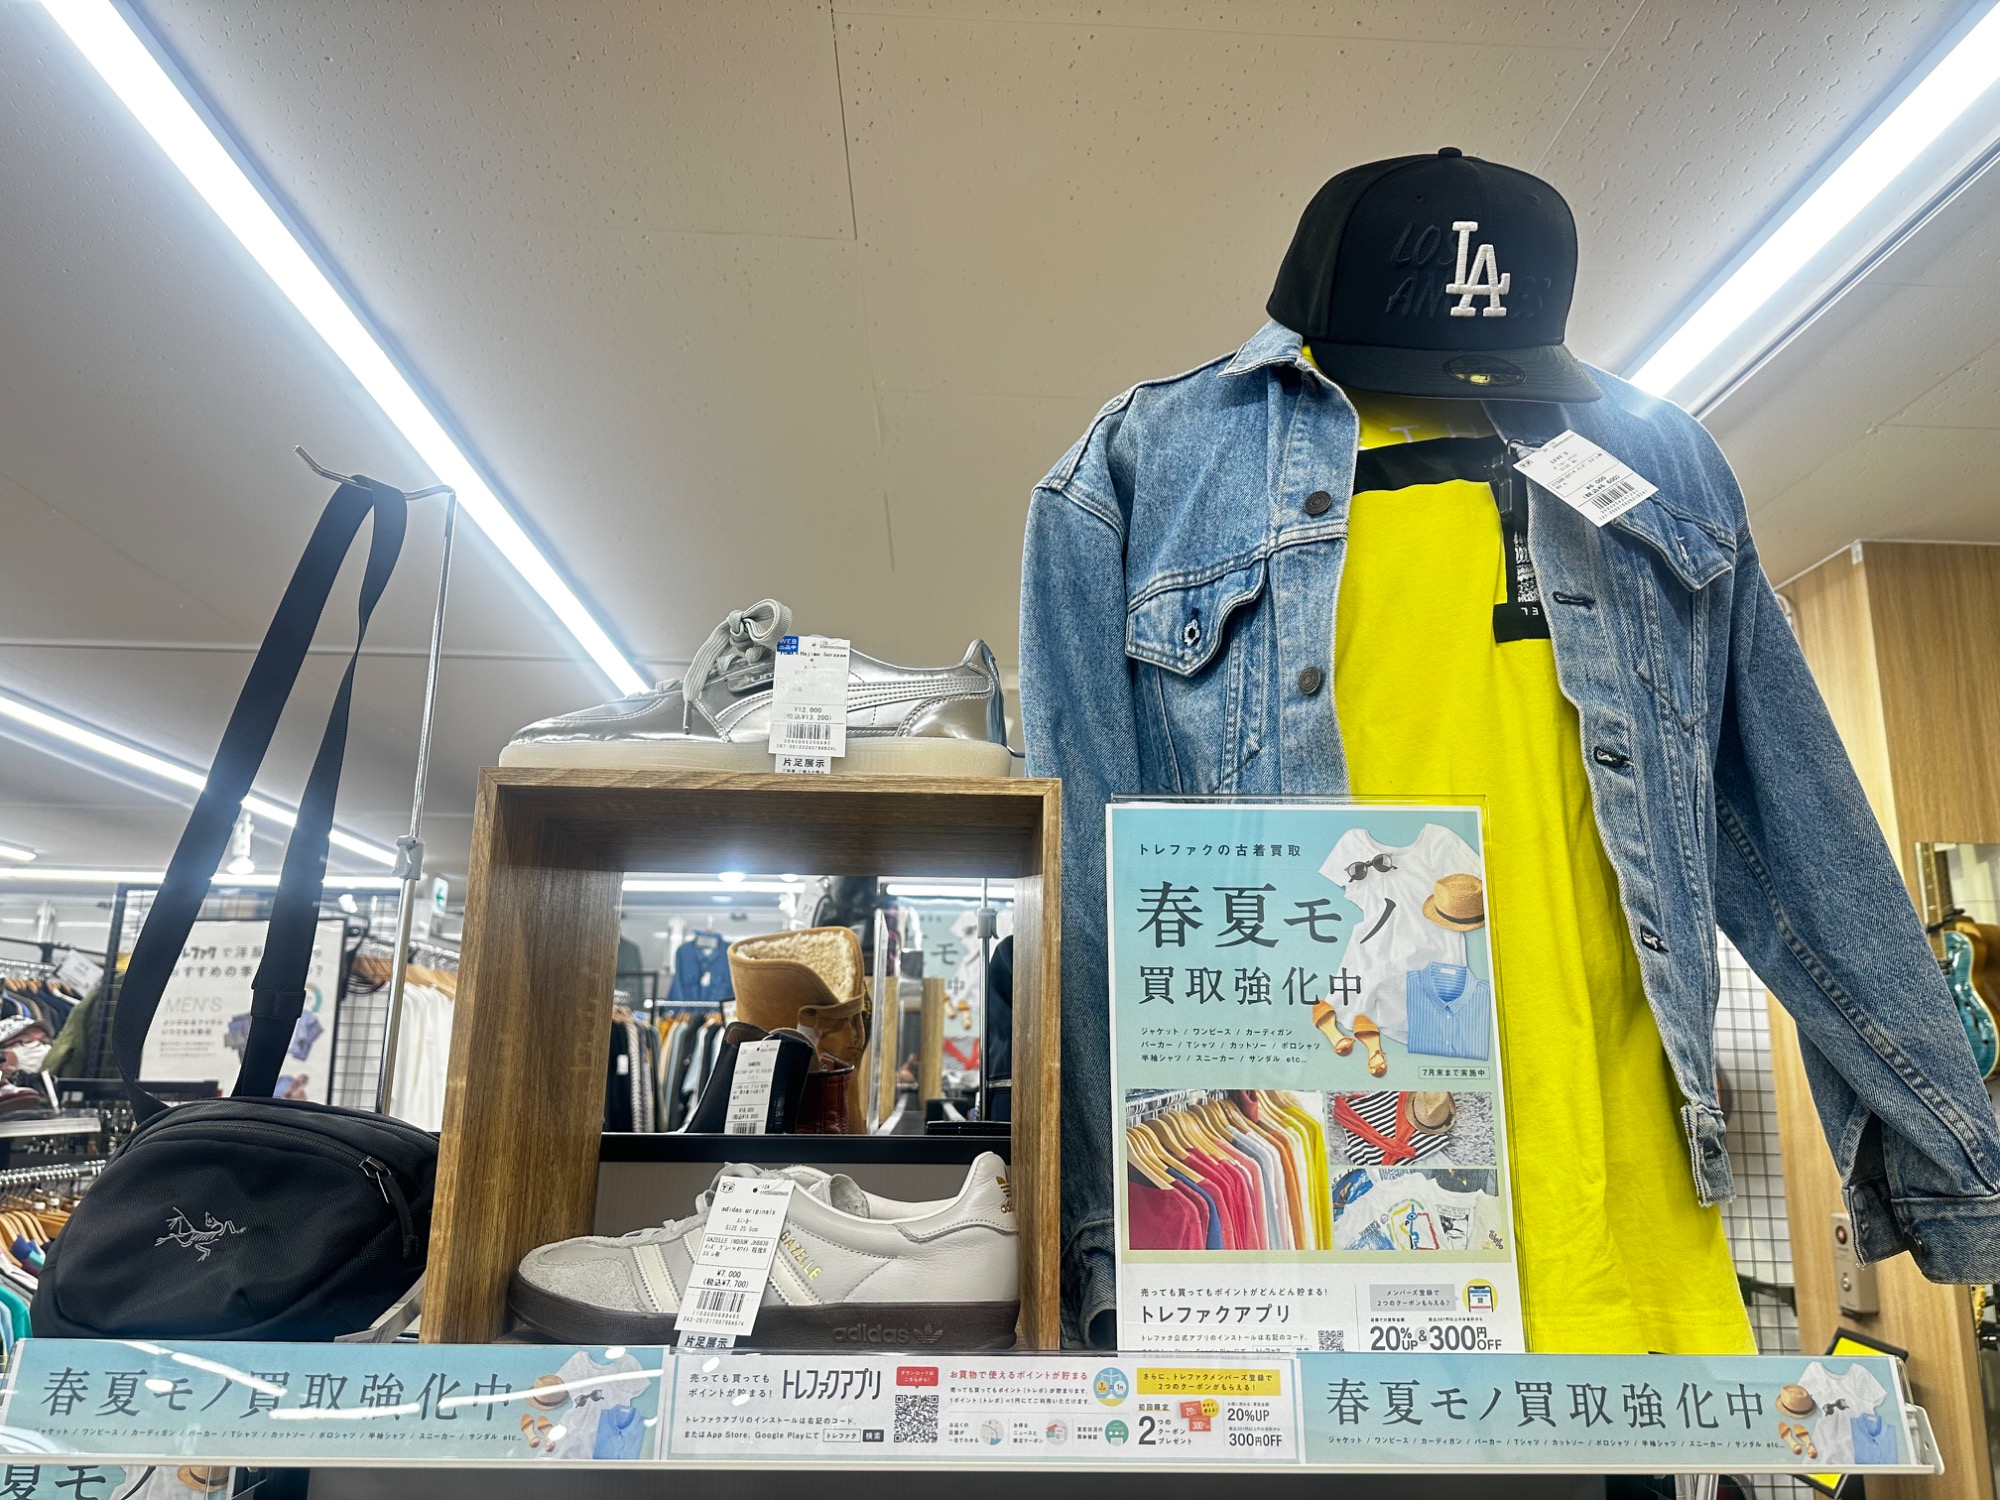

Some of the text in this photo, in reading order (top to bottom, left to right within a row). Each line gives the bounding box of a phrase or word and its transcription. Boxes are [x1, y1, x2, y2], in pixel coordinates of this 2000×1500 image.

[1446, 221, 1511, 317] LA
[783, 757, 825, 768] 片足展示
[1139, 843, 1301, 857] トレファクの古着買取
[1136, 880, 1398, 948] 春夏モノ
[1138, 965, 1362, 1006] 買取強化中
[165, 996, 223, 1013] MEN'S
[1141, 1028, 1293, 1036] ジャケット ワンピース カーディガン
[1141, 1041, 1173, 1049] パーカー
[1281, 1042, 1321, 1050] ポロシャツ
[1141, 1054, 1182, 1062] 半袖シャツ
[1196, 1054, 1234, 1062] スニーカー
[1249, 1054, 1280, 1063] サンダル
[1422, 1068, 1485, 1078] 7月末まで実施中
[780, 1229, 823, 1281] GAZELLE
[717, 1269, 742, 1278] ¥7,000
[703, 1278, 749, 1288] (税込¥7,700)
[1140, 1288, 1328, 1297] 売っても買ってもポイントがどんどん貯まる！
[1386, 1289, 1440, 1297] メンバーズ登録で
[1142, 1303, 1290, 1324] トレファクアプリ
[832, 1323, 910, 1343] adidas
[685, 1335, 728, 1348] 片足展示
[690, 1373, 770, 1384] 売っても買っても
[950, 1370, 1088, 1380] お買物で使えるポイントが貯まる
[1143, 1372, 1273, 1382] さらに、トレファクメンバーズ登録で
[782, 1368, 881, 1400] トレファクアプリ
[41, 1366, 513, 1422] 春夏モノ買取強化中
[1138, 1403, 1169, 1411] 初回限定
[1326, 1377, 1765, 1430] 春夏モノ買取強化中
[1227, 1408, 1270, 1422] 20%UP
[1157, 1418, 1171, 1426] つの
[82, 1428, 118, 1436] ワンピース
[131, 1428, 176, 1437] カーディガン
[230, 1430, 259, 1438] Tシャツ
[270, 1431, 306, 1439] カットソー
[368, 1432, 406, 1440] 半袖シャツ
[419, 1433, 455, 1441] スニーカー
[469, 1433, 498, 1441] サンダル
[1138, 1415, 1157, 1445] 2
[1158, 1428, 1186, 1436] クーポン
[826, 1432, 857, 1440] トレファク
[865, 1432, 881, 1440] 検索
[1158, 1437, 1192, 1446] プレゼント
[1229, 1433, 1283, 1447] 300円OFF
[1328, 1436, 1363, 1444] ジャケット
[1374, 1436, 1409, 1444] ワンピース
[1421, 1437, 1463, 1445] カーディガン
[1513, 1437, 1539, 1446] Tシャツ
[1552, 1438, 1584, 1446] カットソー
[1641, 1439, 1677, 1448] 半袖シャツ
[1689, 1440, 1723, 1448] スニーカー
[1735, 1440, 1762, 1448] サンダル
